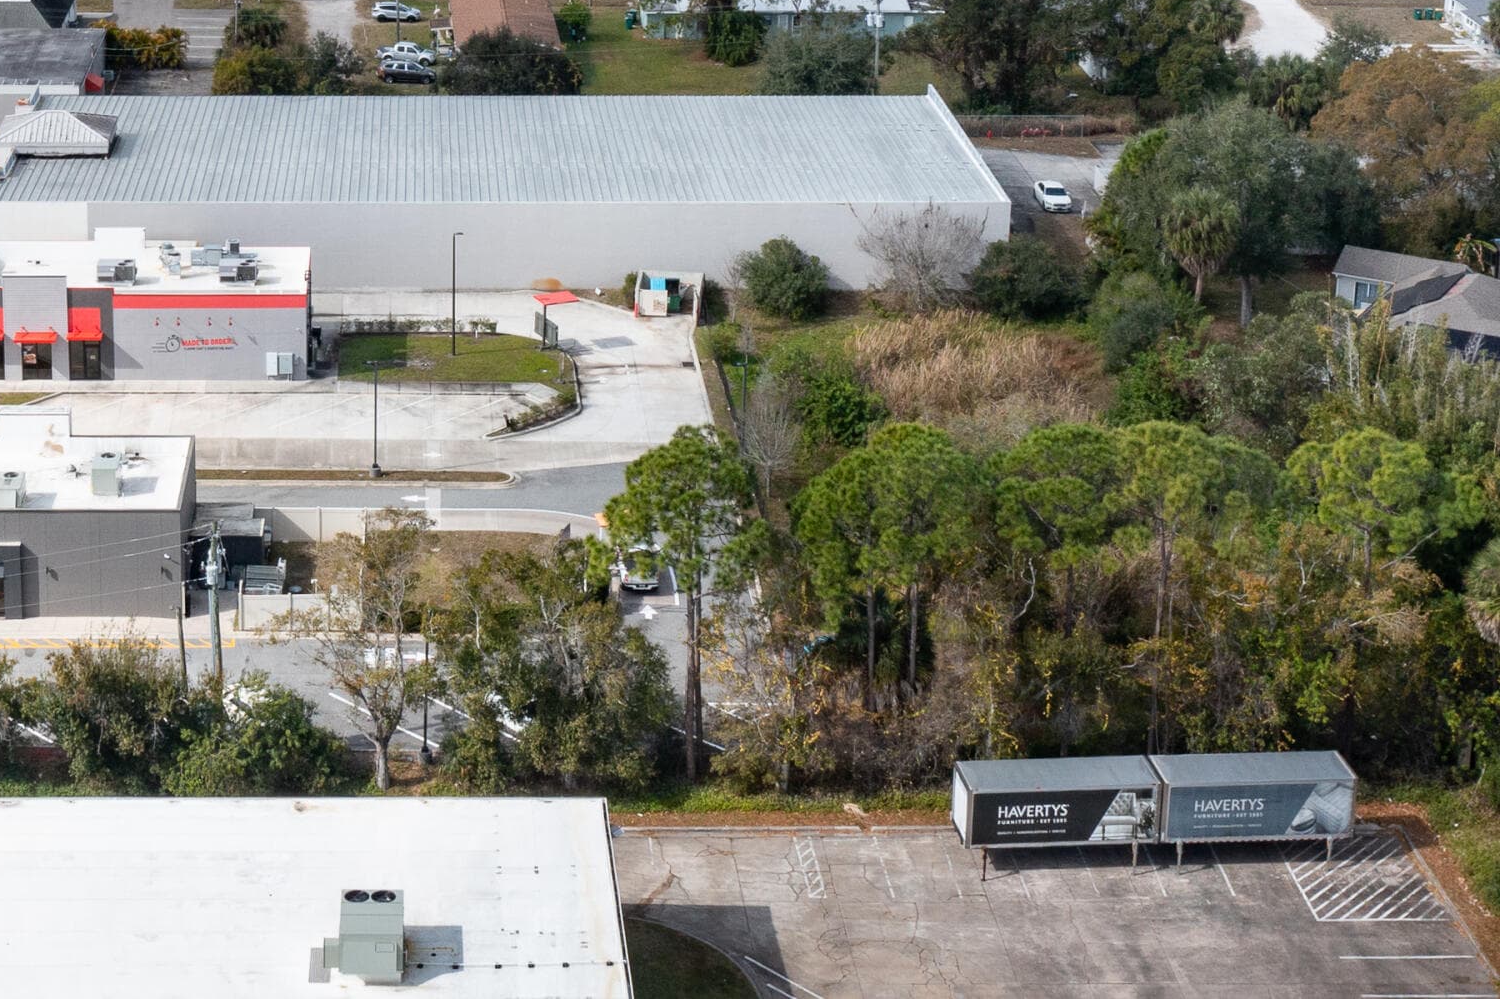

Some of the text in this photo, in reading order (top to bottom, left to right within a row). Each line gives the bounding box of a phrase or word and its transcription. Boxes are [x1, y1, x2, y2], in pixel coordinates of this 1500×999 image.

[181, 338, 199, 346] MADE
[998, 804, 1068, 819] HAVERTYS
[1194, 799, 1265, 812] HAVERTYS
